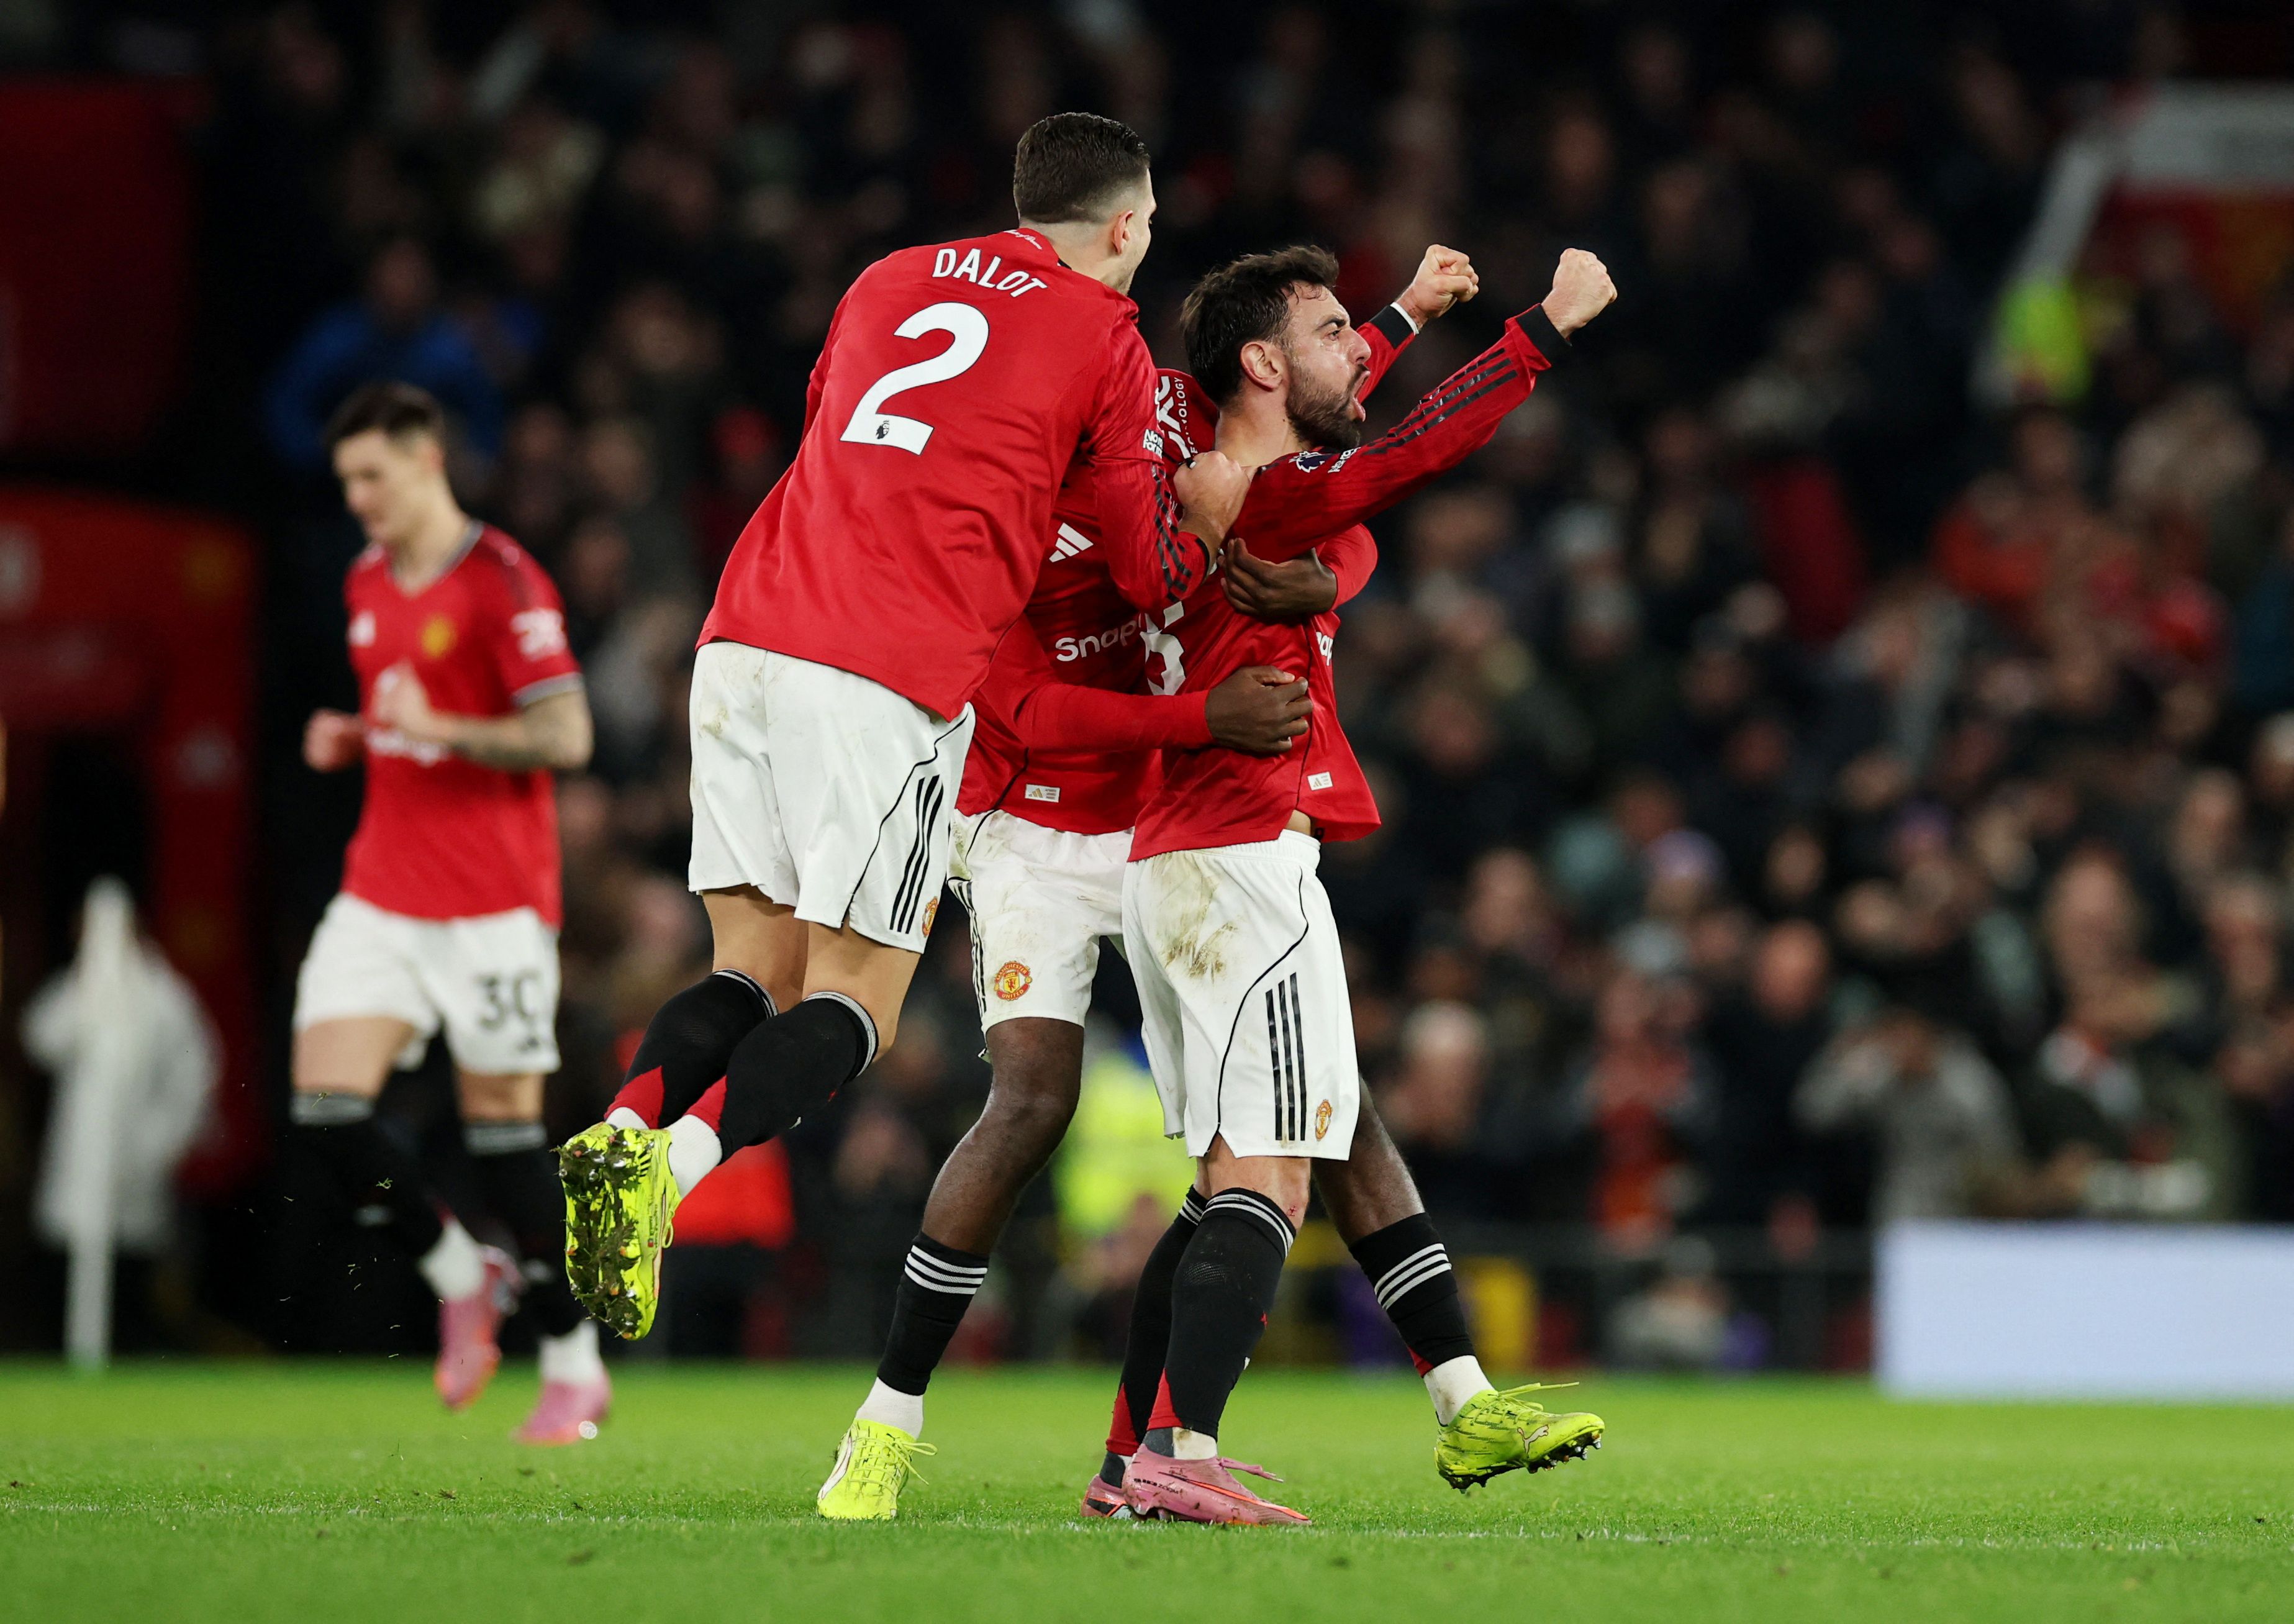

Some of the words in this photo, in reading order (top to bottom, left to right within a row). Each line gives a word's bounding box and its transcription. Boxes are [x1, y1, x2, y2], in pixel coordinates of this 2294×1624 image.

[933, 248, 1047, 297] DALOT
[840, 302, 989, 455] 2
[1055, 613, 1141, 661] Snap
[997, 963, 1027, 981] MANCHESTER
[1002, 989, 1024, 998] UNITED
